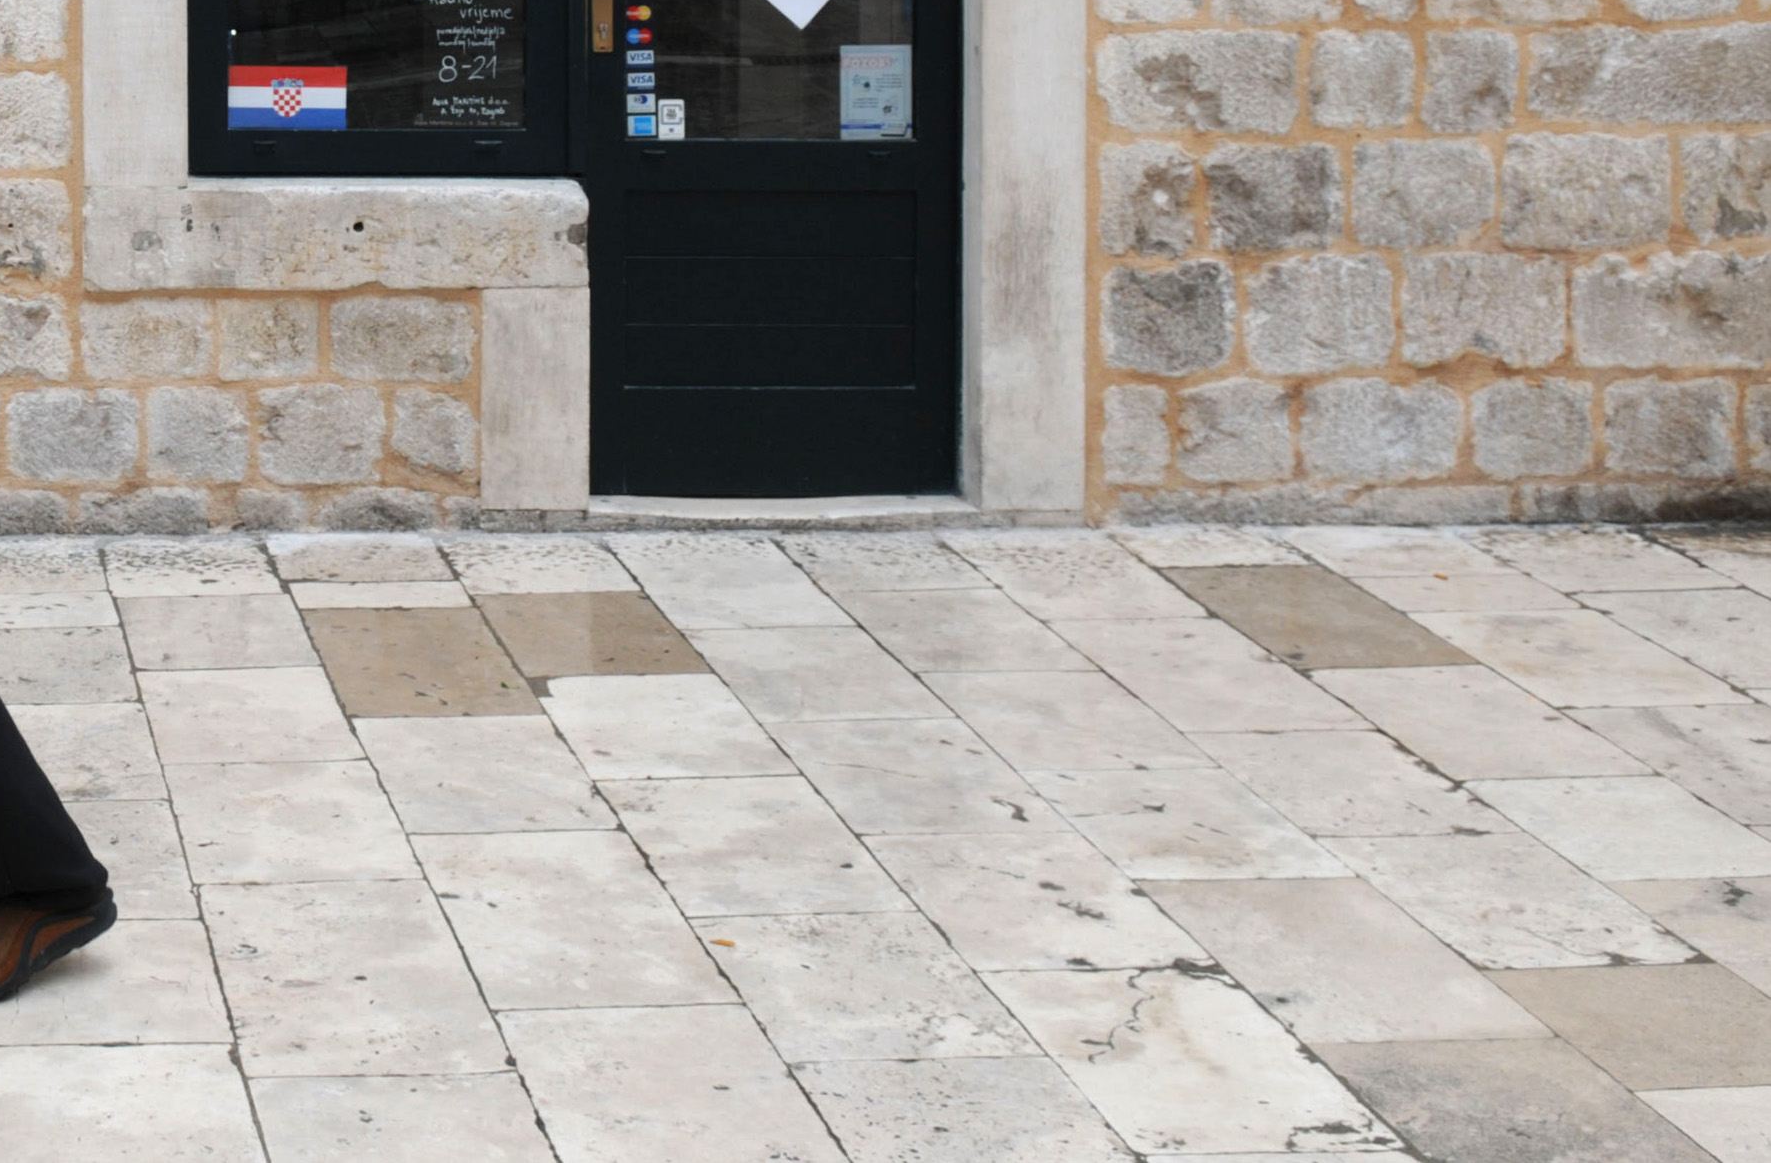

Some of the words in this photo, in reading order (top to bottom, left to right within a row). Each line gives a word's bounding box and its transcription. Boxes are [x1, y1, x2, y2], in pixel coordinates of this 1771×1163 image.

[459, 4, 514, 24] vrijeme
[629, 52, 653, 62] VISA
[630, 75, 654, 85] VISA
